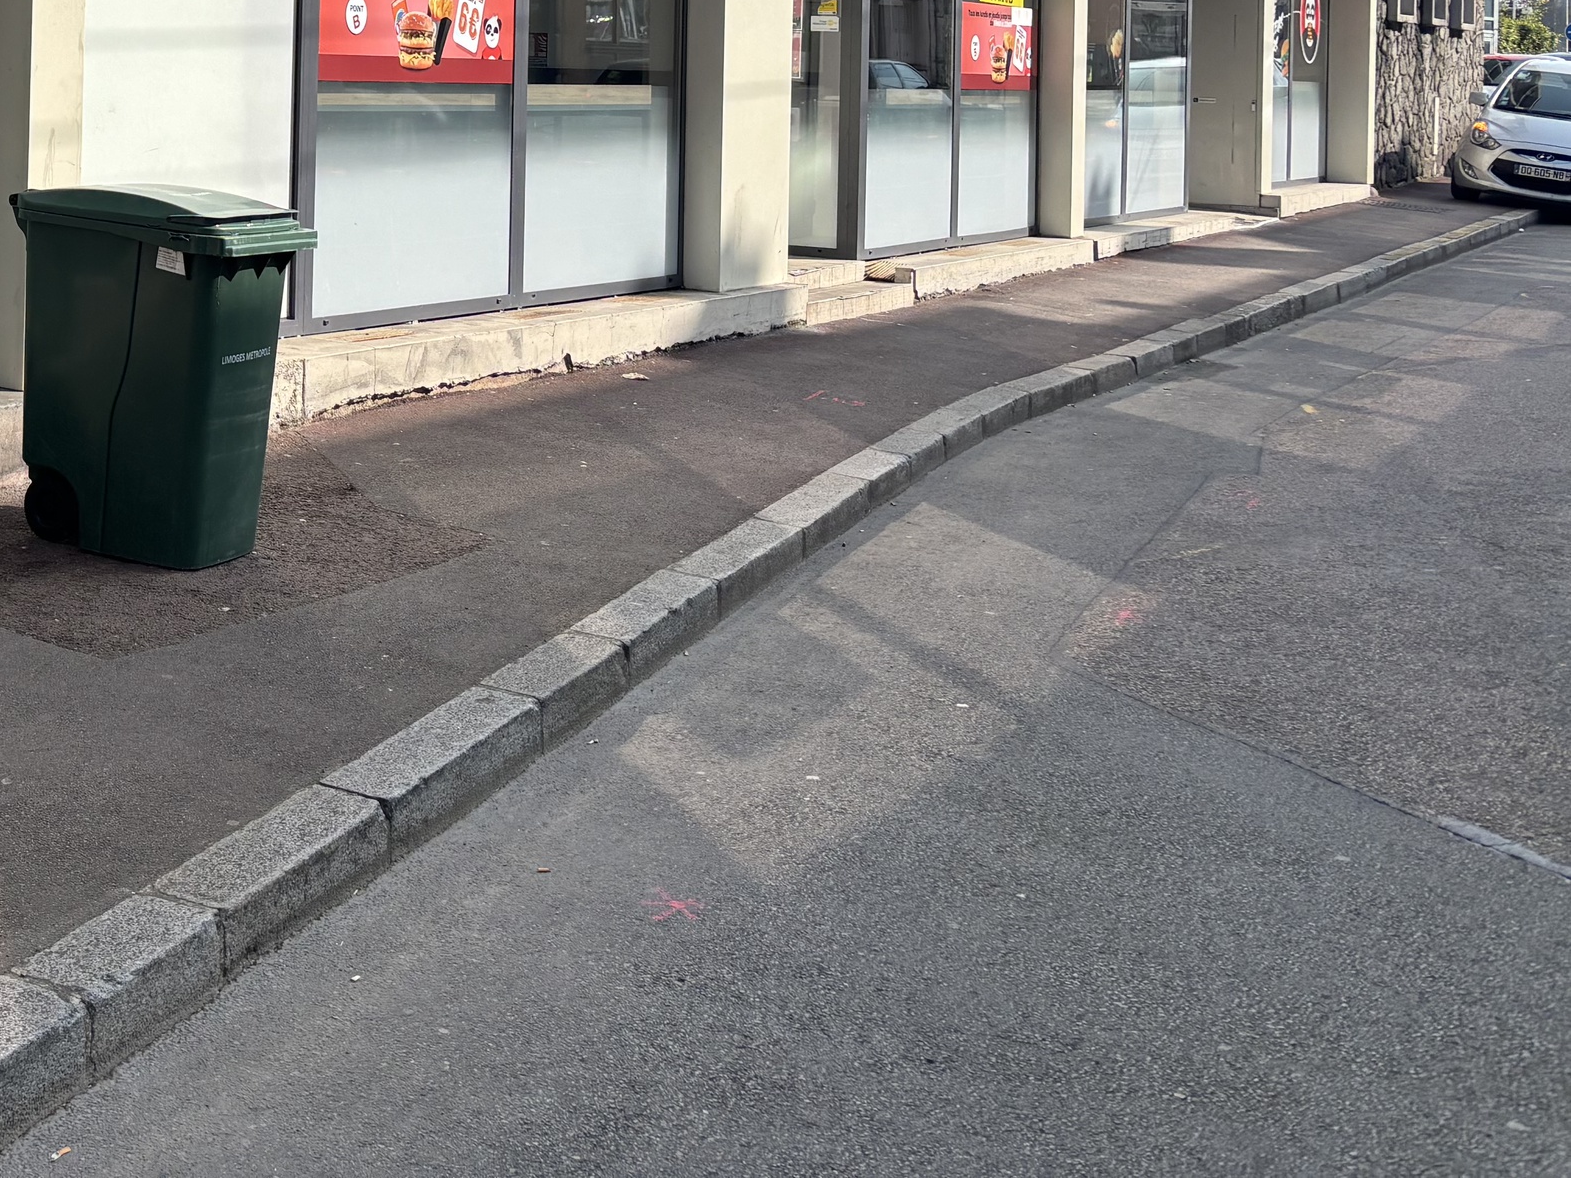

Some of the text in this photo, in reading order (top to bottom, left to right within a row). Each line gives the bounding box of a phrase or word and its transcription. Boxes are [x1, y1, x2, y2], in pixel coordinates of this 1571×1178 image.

[350, 4, 364, 12] POINT
[352, 14, 361, 29] B
[221, 352, 245, 365] LIMOGES
